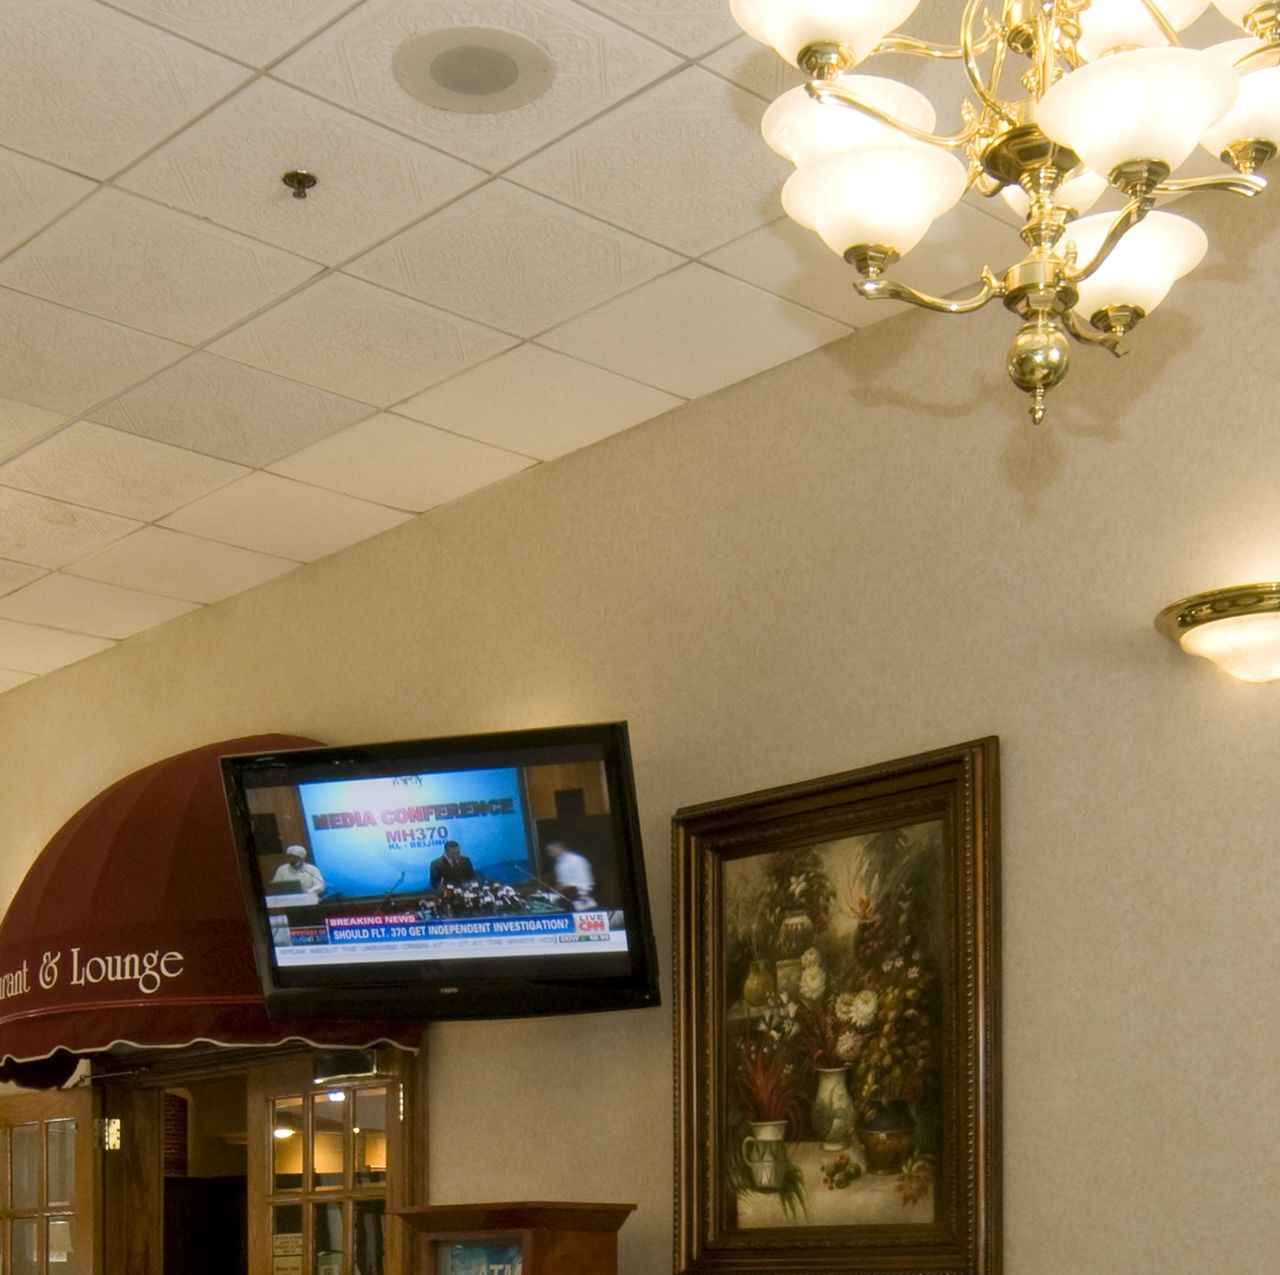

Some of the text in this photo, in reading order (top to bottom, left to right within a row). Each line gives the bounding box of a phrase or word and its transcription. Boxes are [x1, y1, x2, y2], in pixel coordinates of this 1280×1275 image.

[312, 798, 515, 831] MEDIA CONFERENCE
[385, 826, 449, 844] MH370
[330, 914, 416, 927] BREAKING NEWS
[578, 920, 605, 932] CNN
[579, 914, 604, 922] LIVE
[333, 928, 370, 940] SHOULD
[371, 927, 390, 938] FLT.
[391, 926, 407, 938] 370
[409, 925, 427, 937] GET
[429, 921, 491, 936] INDEPENDENT
[493, 919, 570, 932] INVESTIGATION?
[39, 951, 61, 989] &
[70, 947, 184, 993] Lounge
